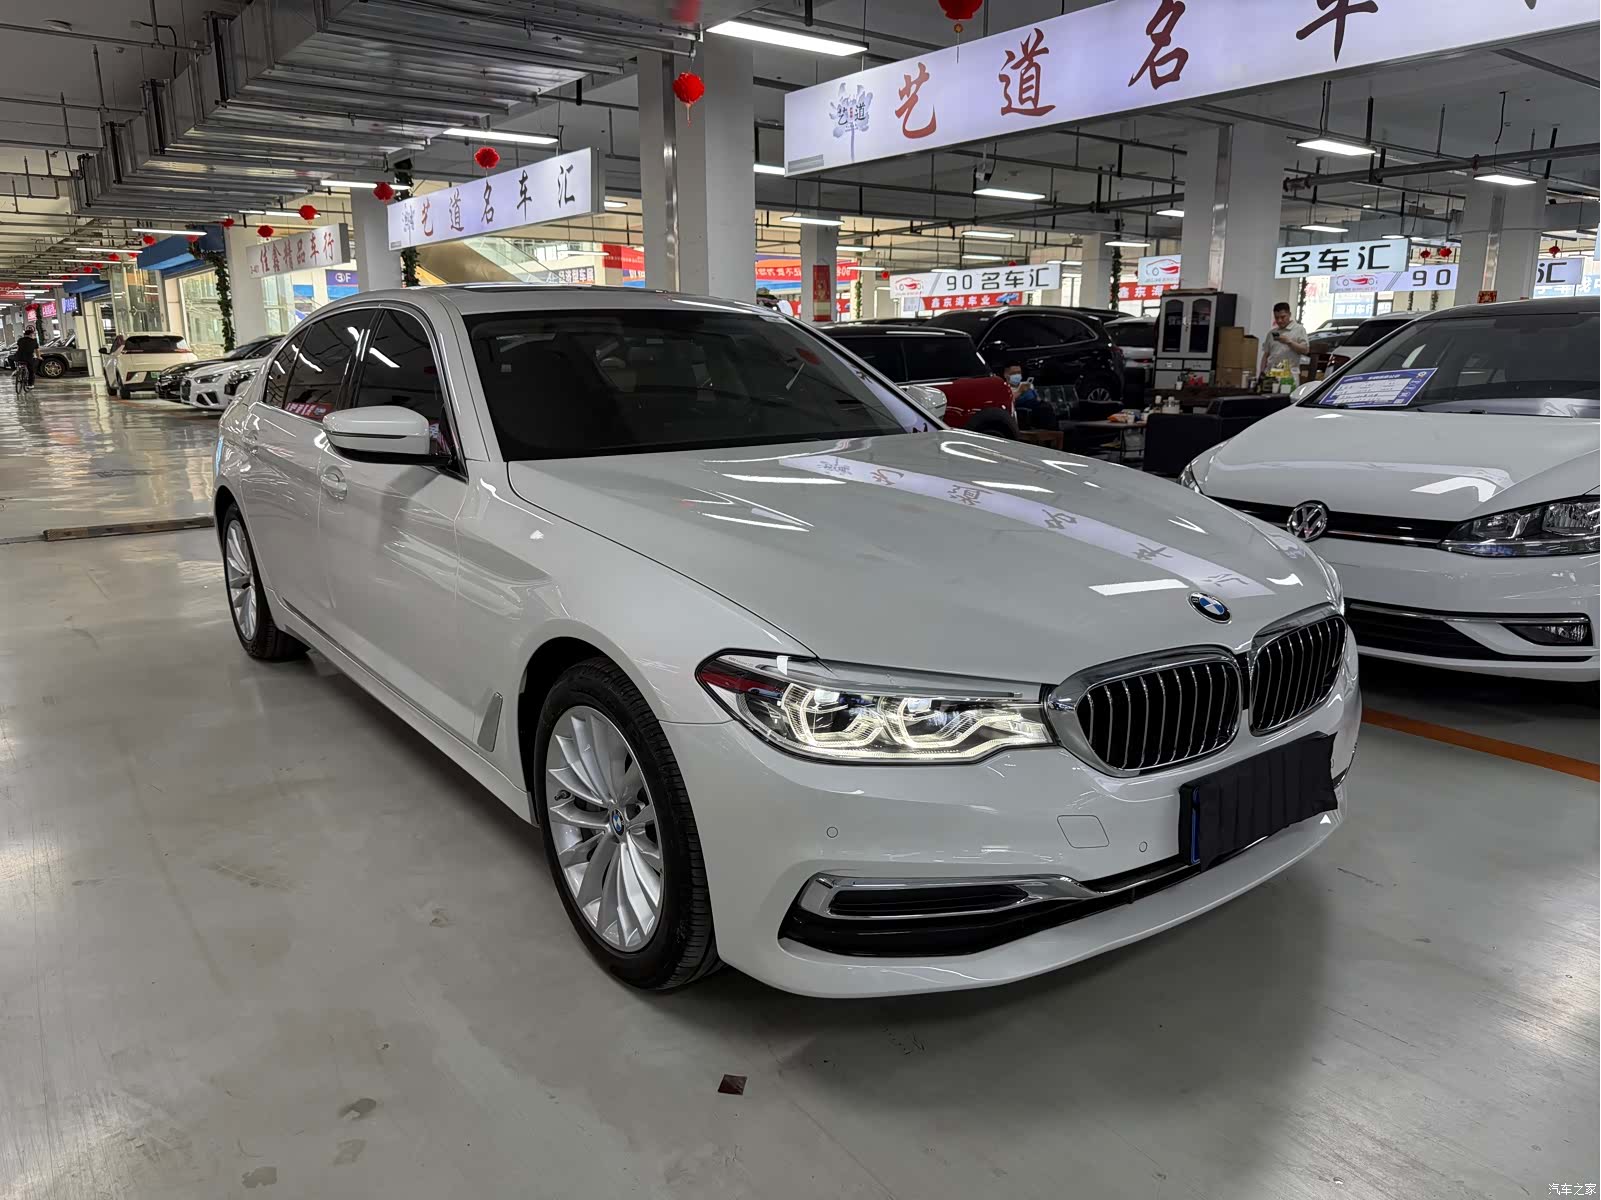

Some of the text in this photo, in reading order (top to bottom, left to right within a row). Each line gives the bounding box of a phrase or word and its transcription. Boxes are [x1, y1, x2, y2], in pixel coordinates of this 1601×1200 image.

[421, 164, 576, 237] 艺道名车汇
[1280, 244, 1391, 275] 名车汇
[946, 267, 1050, 291] 90名车汇
[1412, 269, 1451, 287] 90
